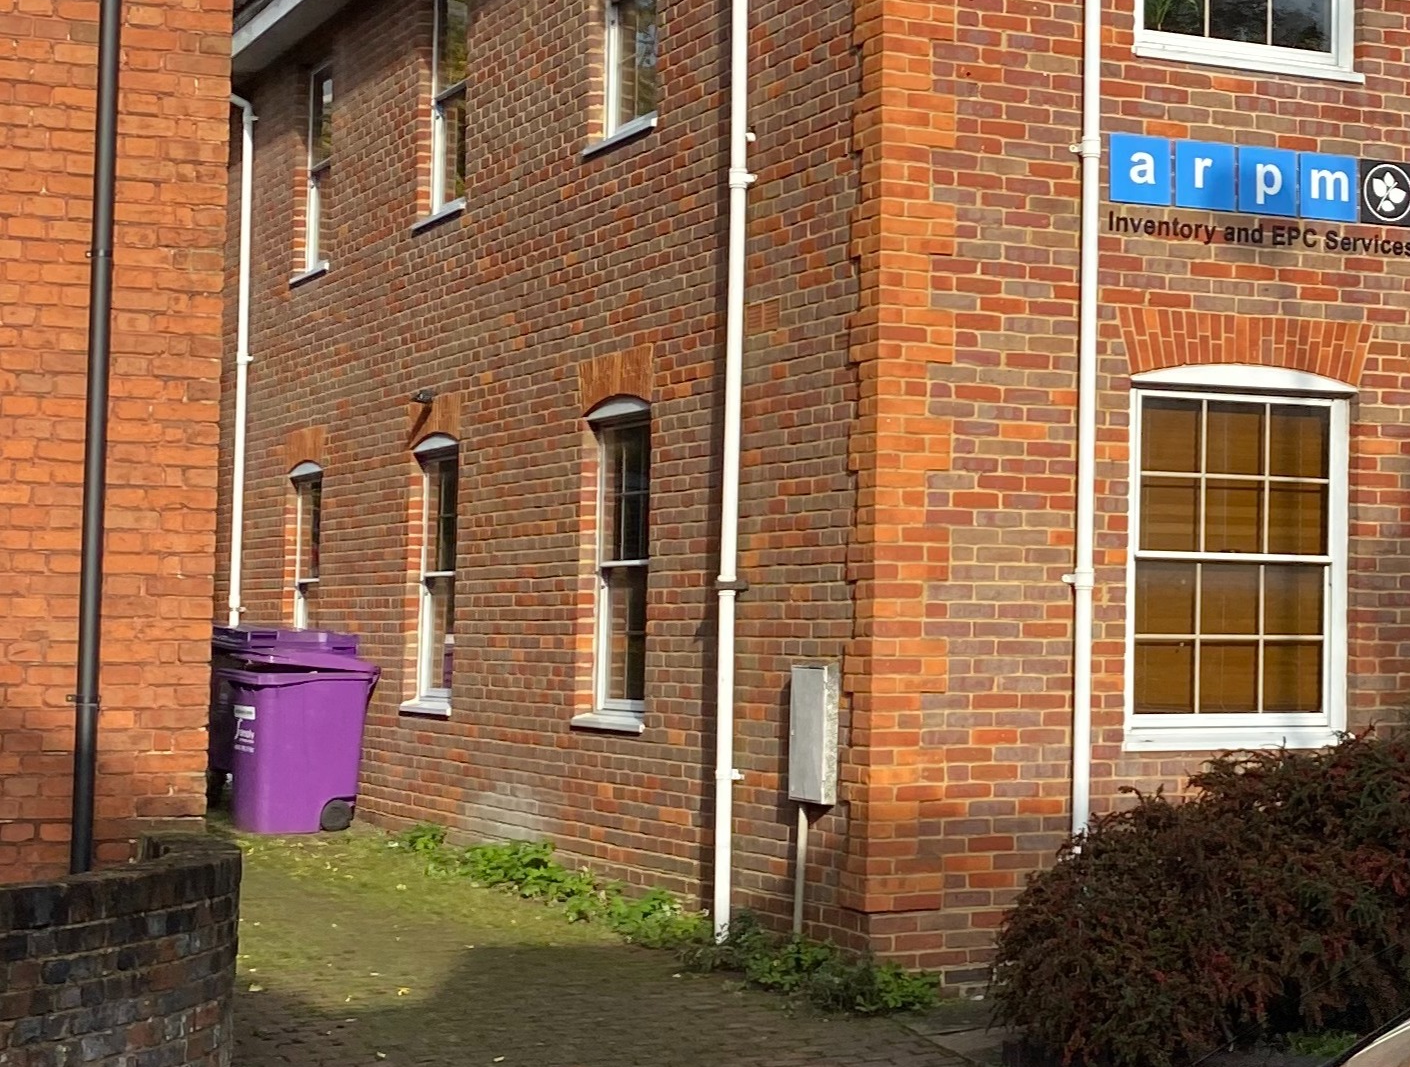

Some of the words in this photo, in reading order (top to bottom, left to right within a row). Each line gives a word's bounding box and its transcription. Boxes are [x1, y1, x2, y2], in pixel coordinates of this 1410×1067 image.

[1108, 211, 1216, 245] Inventory
[1224, 224, 1264, 244] and
[1272, 225, 1318, 248] EPC
